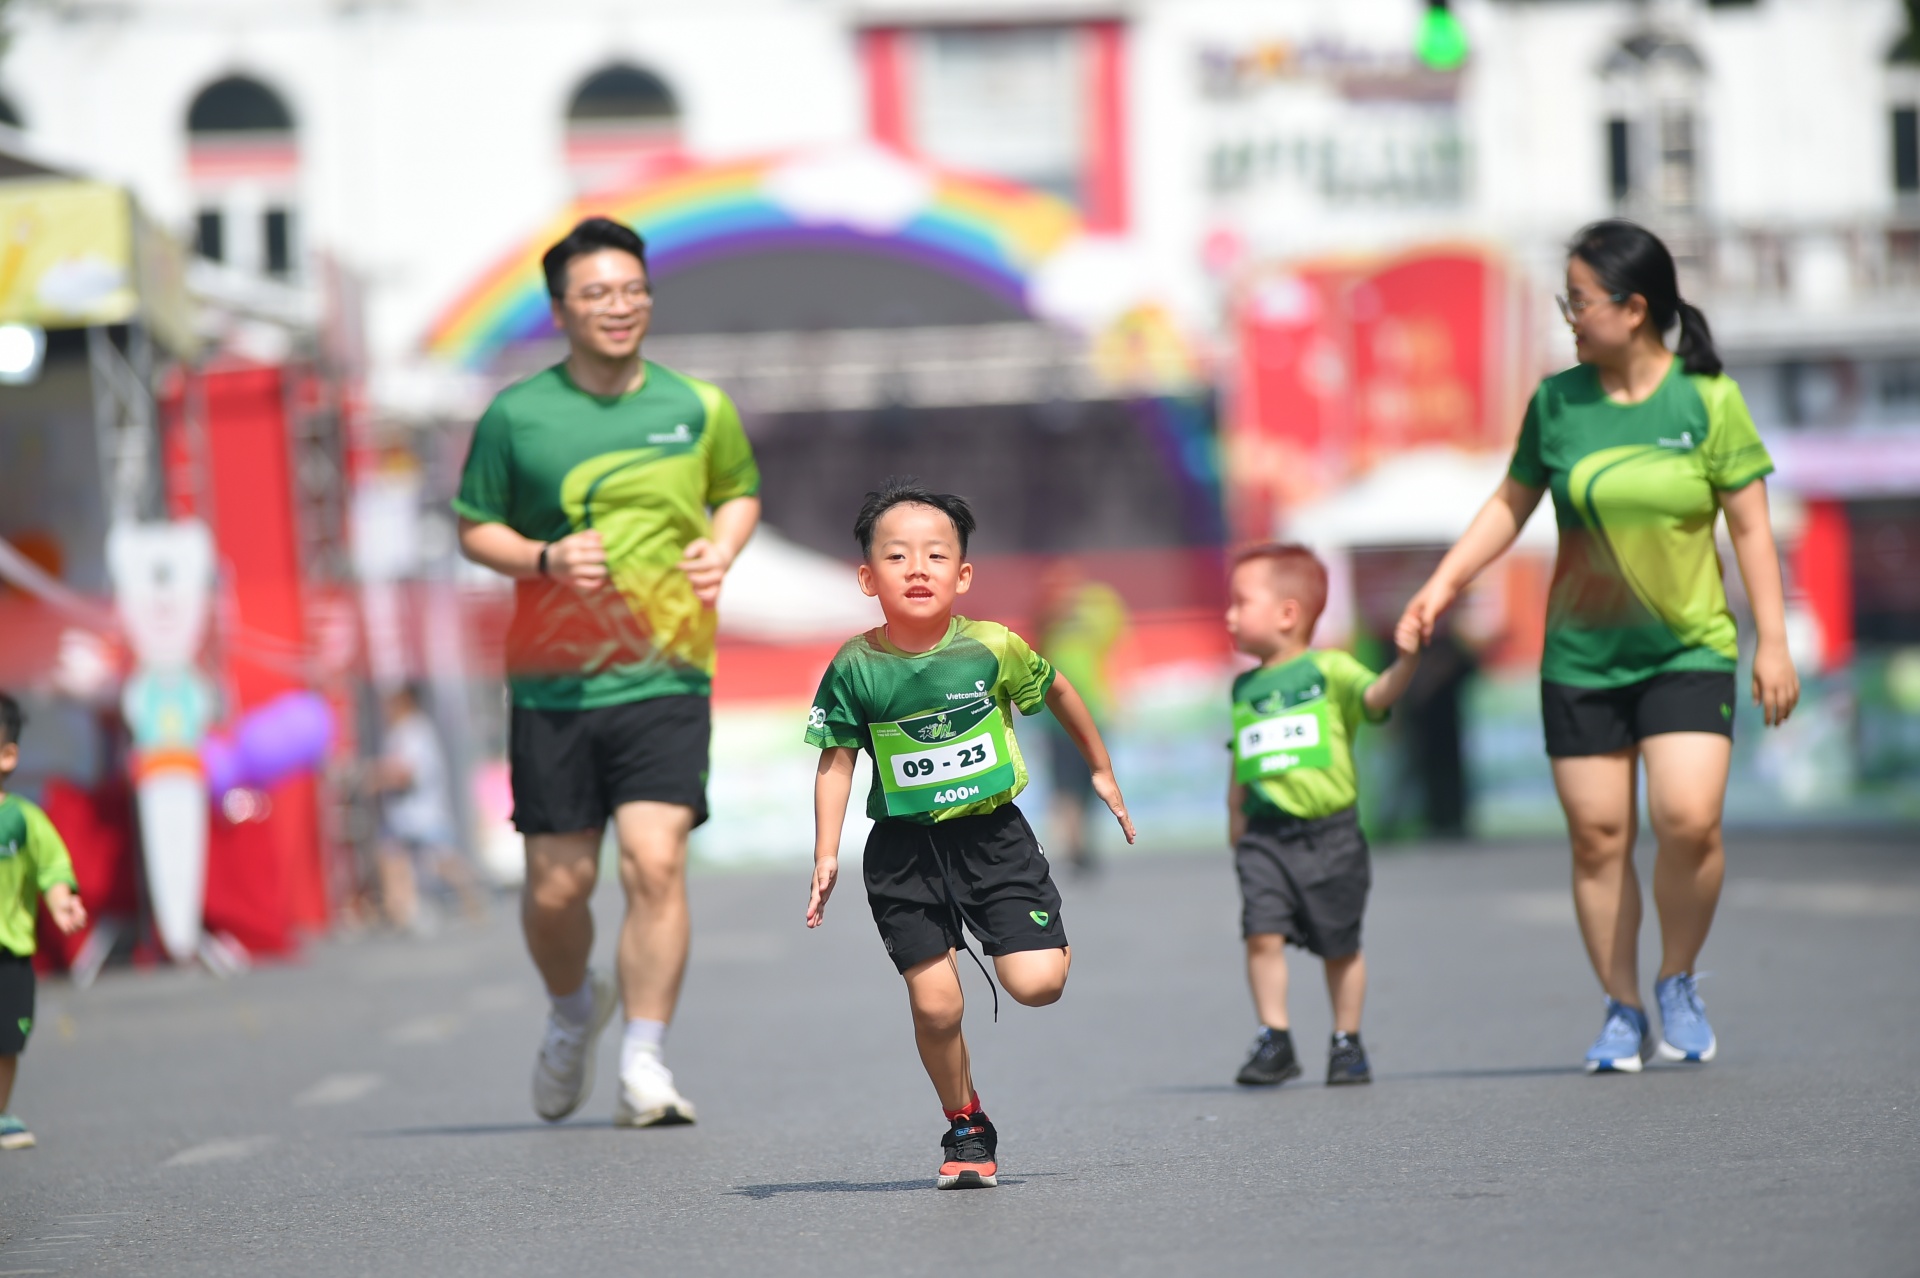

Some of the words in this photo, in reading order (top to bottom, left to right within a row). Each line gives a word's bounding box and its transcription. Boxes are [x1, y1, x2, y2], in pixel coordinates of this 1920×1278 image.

[946, 690, 988, 701] Vietcombank
[902, 758, 934, 778] 09
[956, 743, 987, 768] 23
